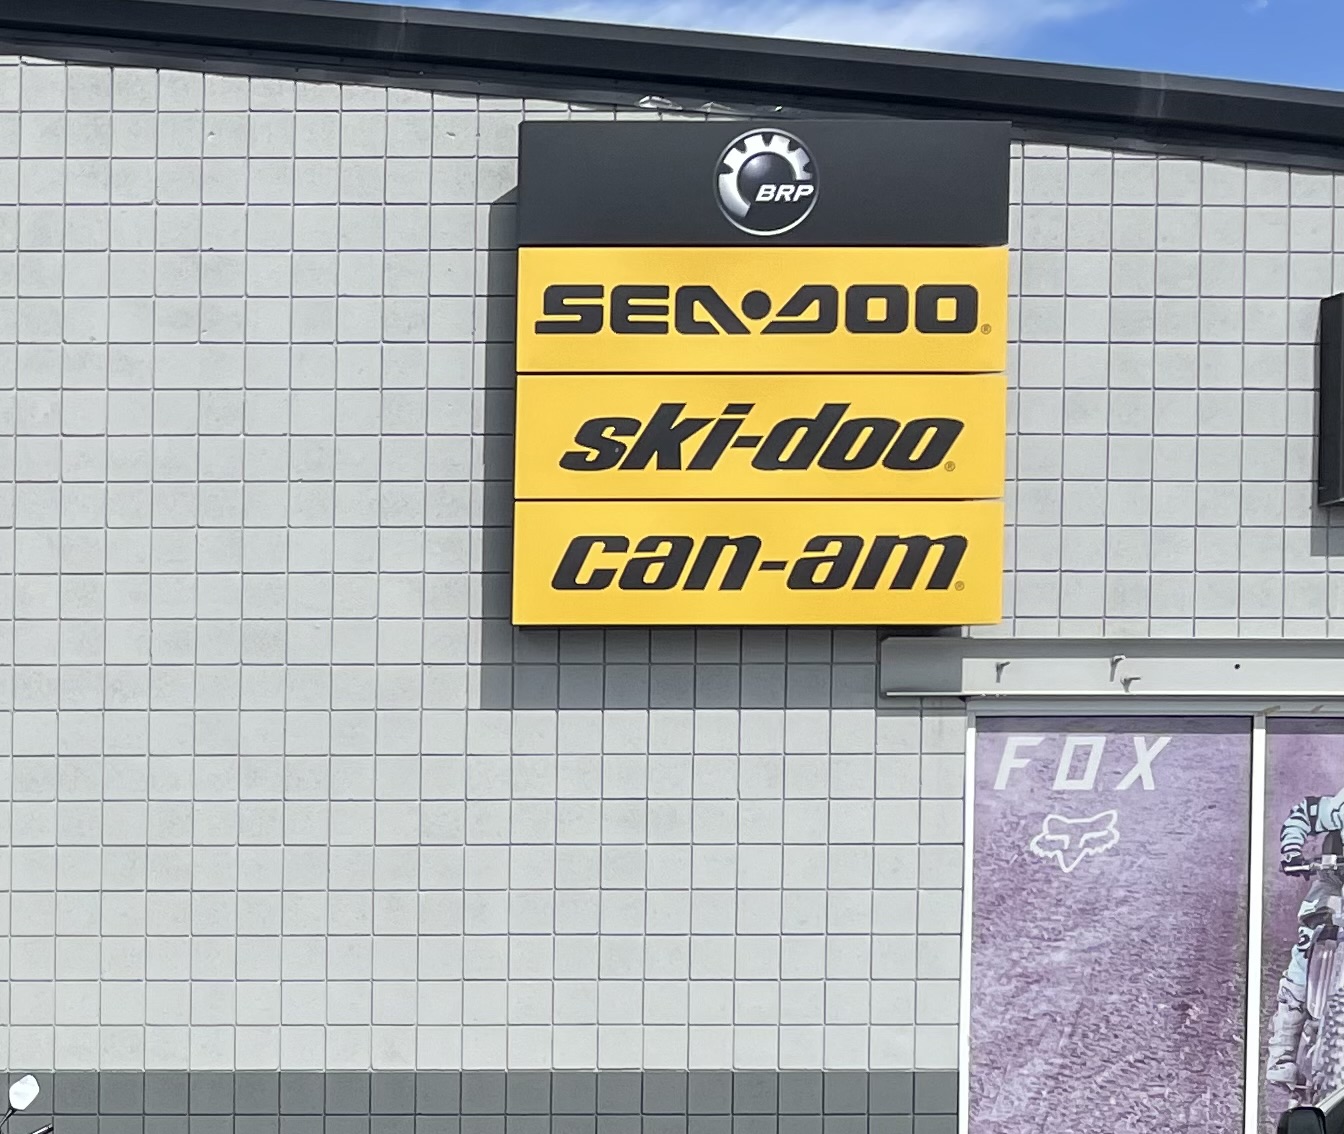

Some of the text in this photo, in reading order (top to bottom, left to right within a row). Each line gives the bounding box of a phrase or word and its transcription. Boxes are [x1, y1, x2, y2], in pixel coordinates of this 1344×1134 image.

[755, 183, 814, 203] BRP
[551, 534, 968, 590] can-am
[994, 736, 1171, 791] FOX
